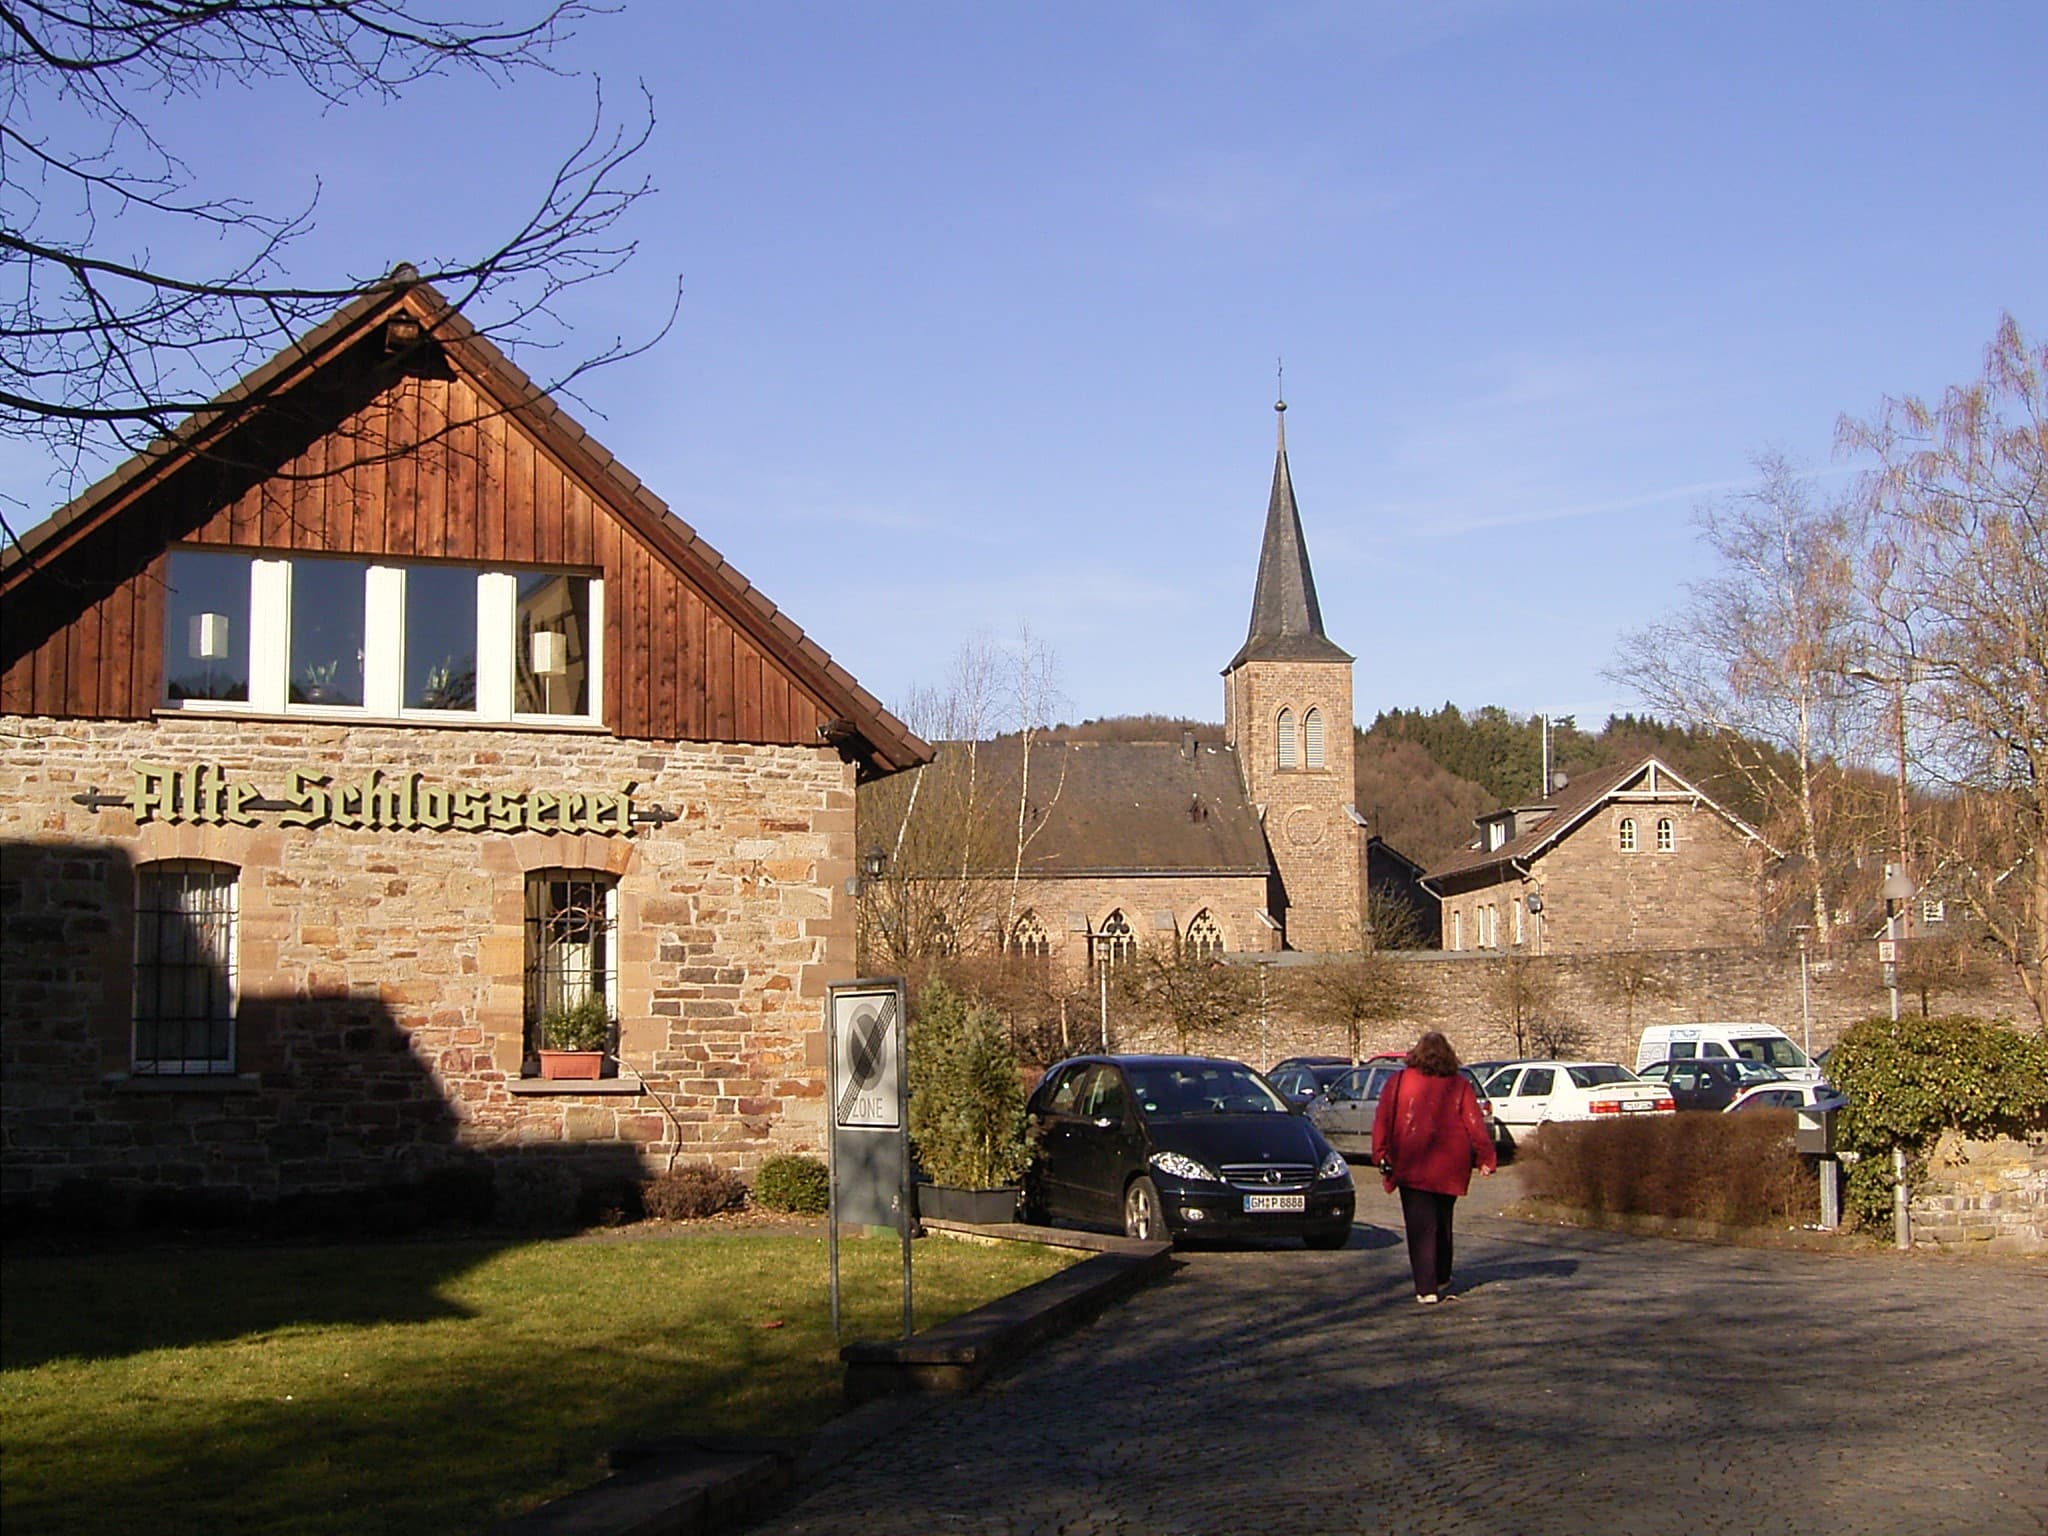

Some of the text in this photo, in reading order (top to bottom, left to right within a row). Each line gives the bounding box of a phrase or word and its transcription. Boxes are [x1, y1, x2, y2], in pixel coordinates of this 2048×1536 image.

[125, 758, 641, 836] Alte Schlosserei
[851, 1097, 884, 1119] ZONE
